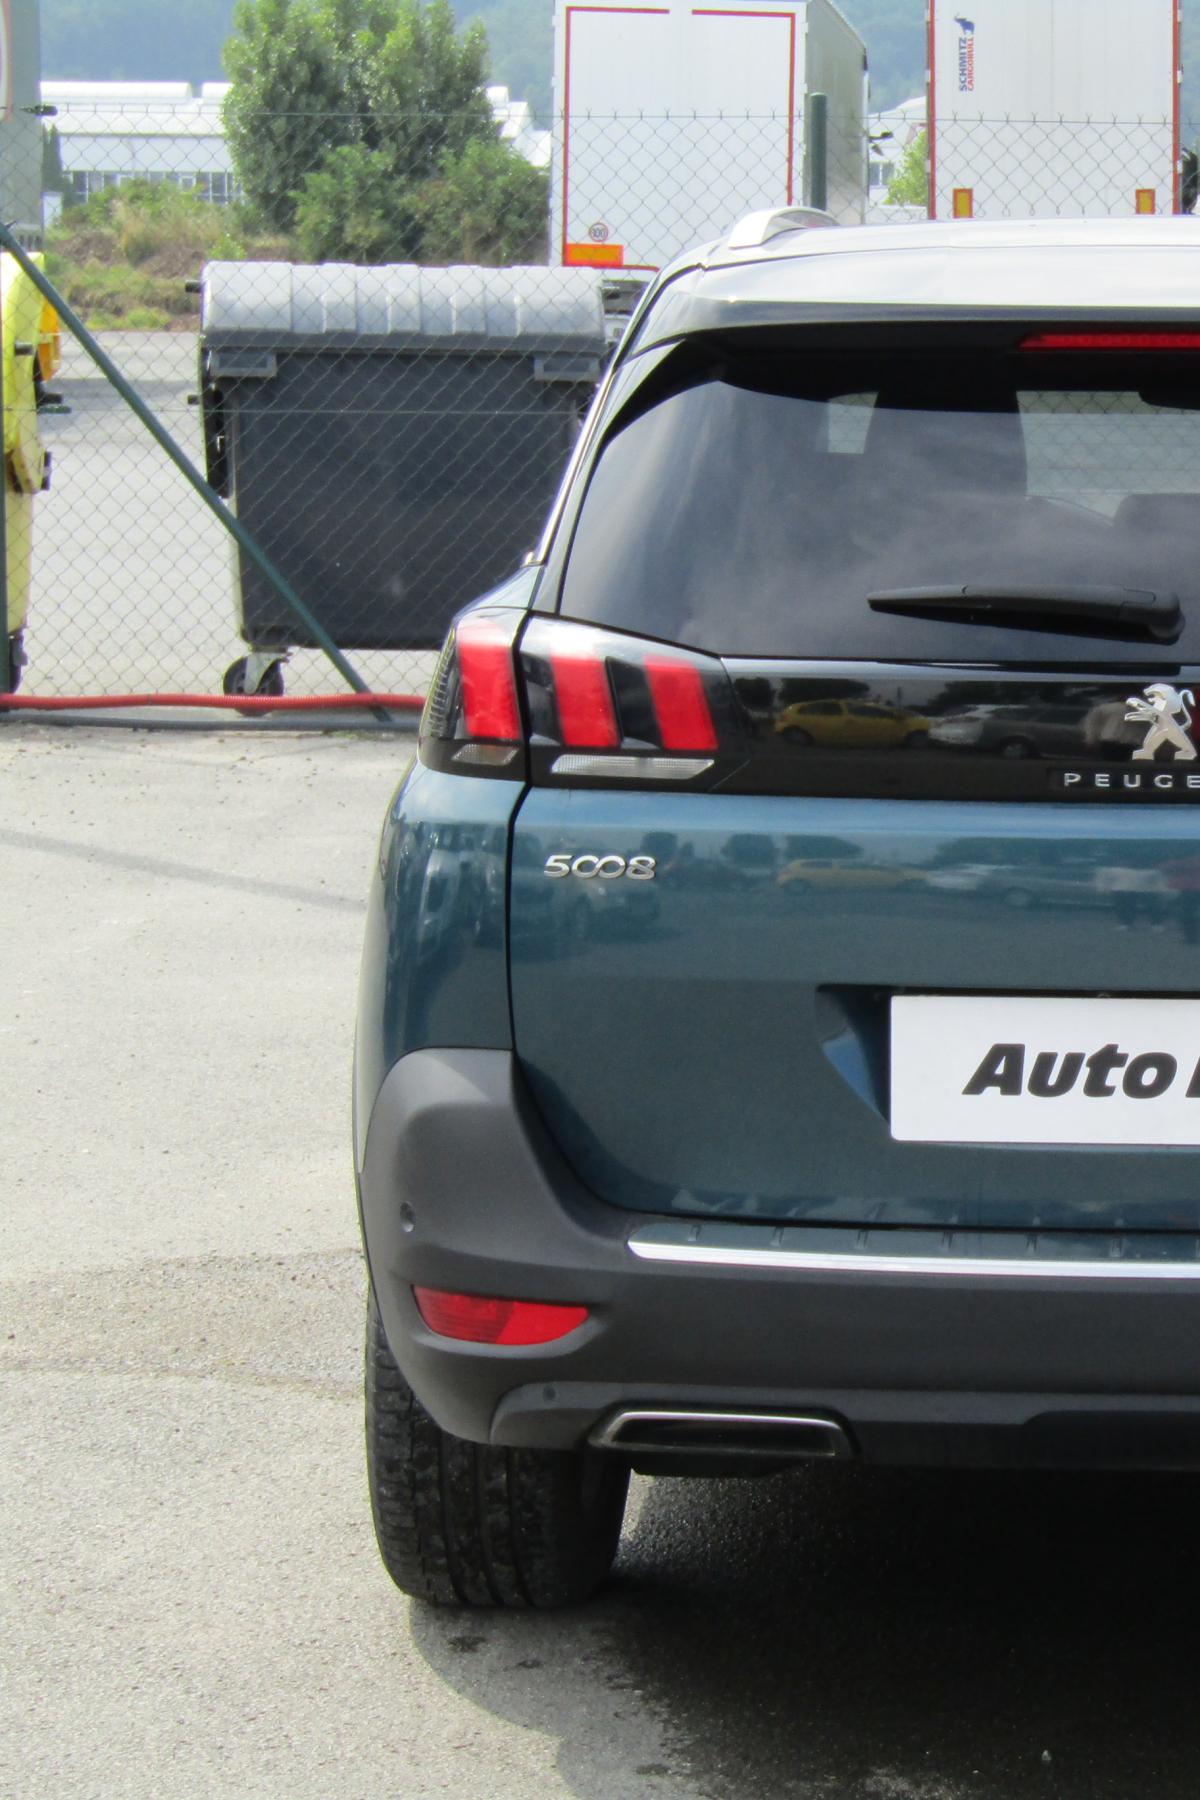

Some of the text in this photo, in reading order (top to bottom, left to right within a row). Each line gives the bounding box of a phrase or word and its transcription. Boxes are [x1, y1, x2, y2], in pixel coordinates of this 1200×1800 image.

[959, 37, 967, 91] SCHMITZ
[543, 854, 656, 880] 5008
[962, 1043, 1177, 1099] Auto
